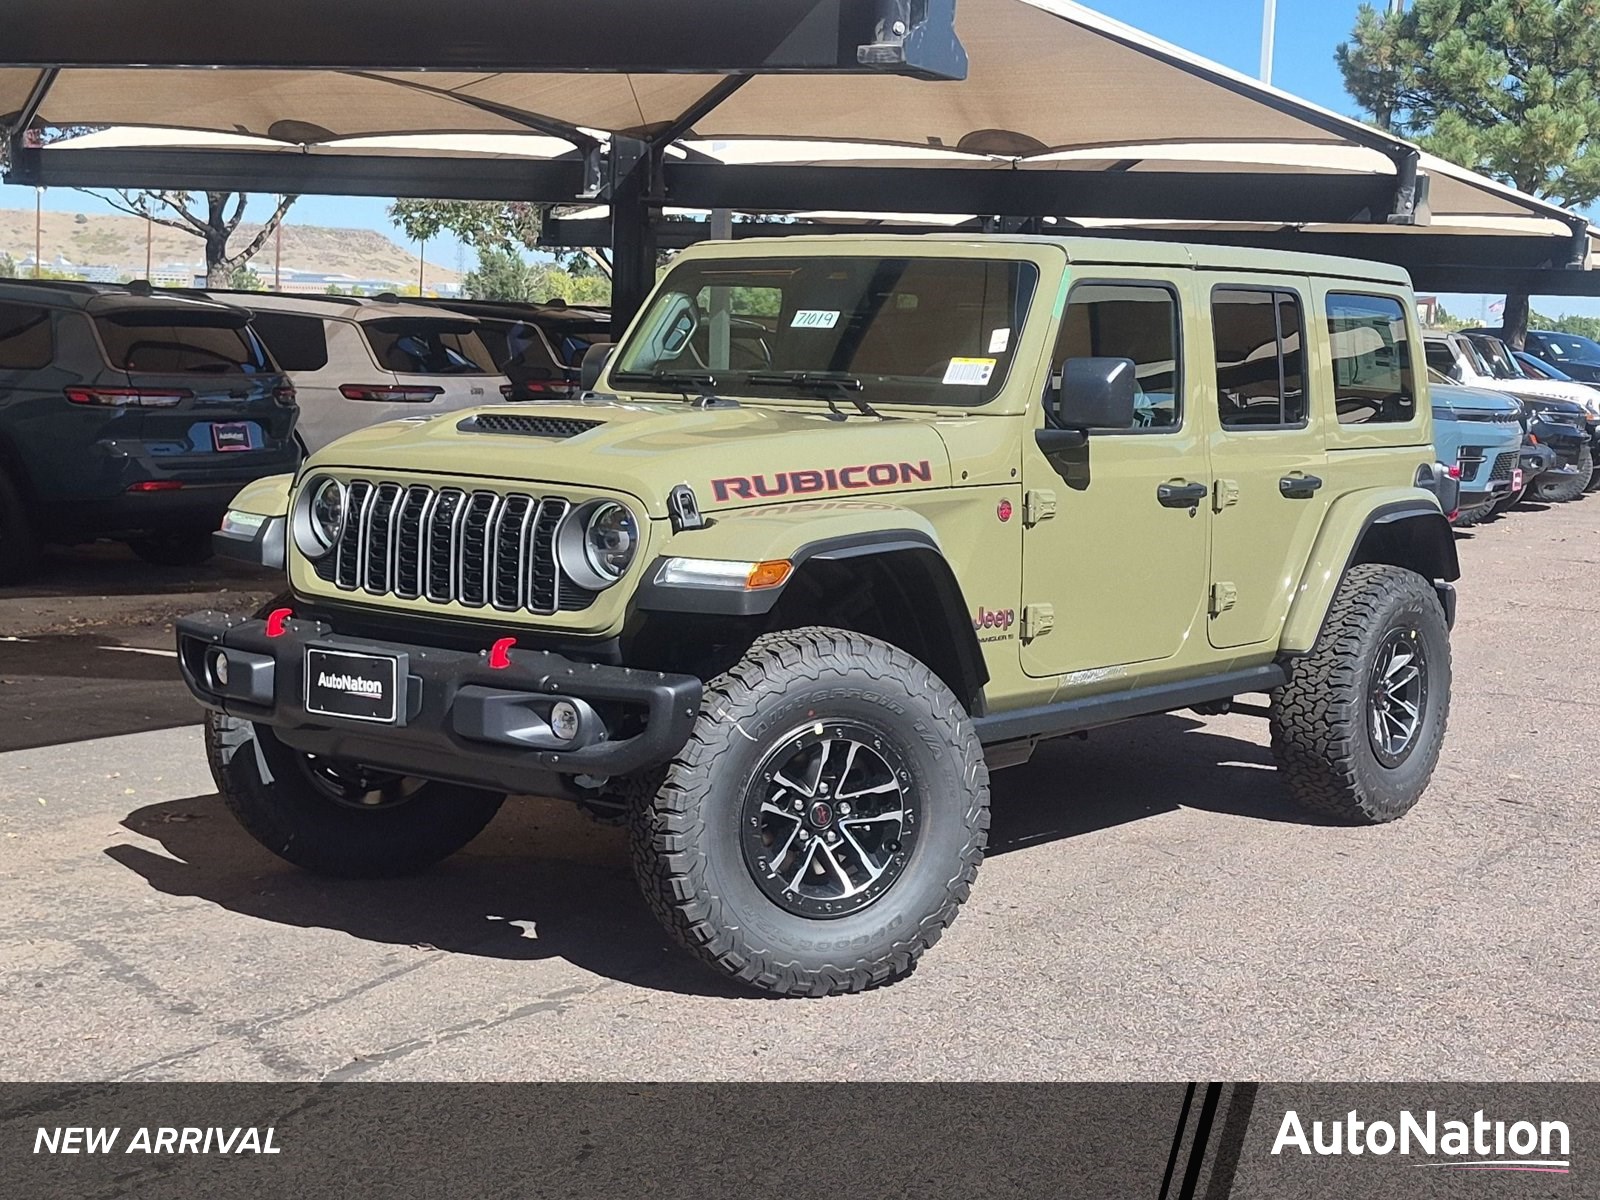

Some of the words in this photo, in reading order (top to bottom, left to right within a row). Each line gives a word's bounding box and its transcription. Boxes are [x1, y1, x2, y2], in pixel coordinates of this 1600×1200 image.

[796, 312, 834, 326] 71019
[711, 460, 933, 502] RUBICON
[972, 606, 1015, 632] Jeep
[317, 671, 383, 694] AutoNation
